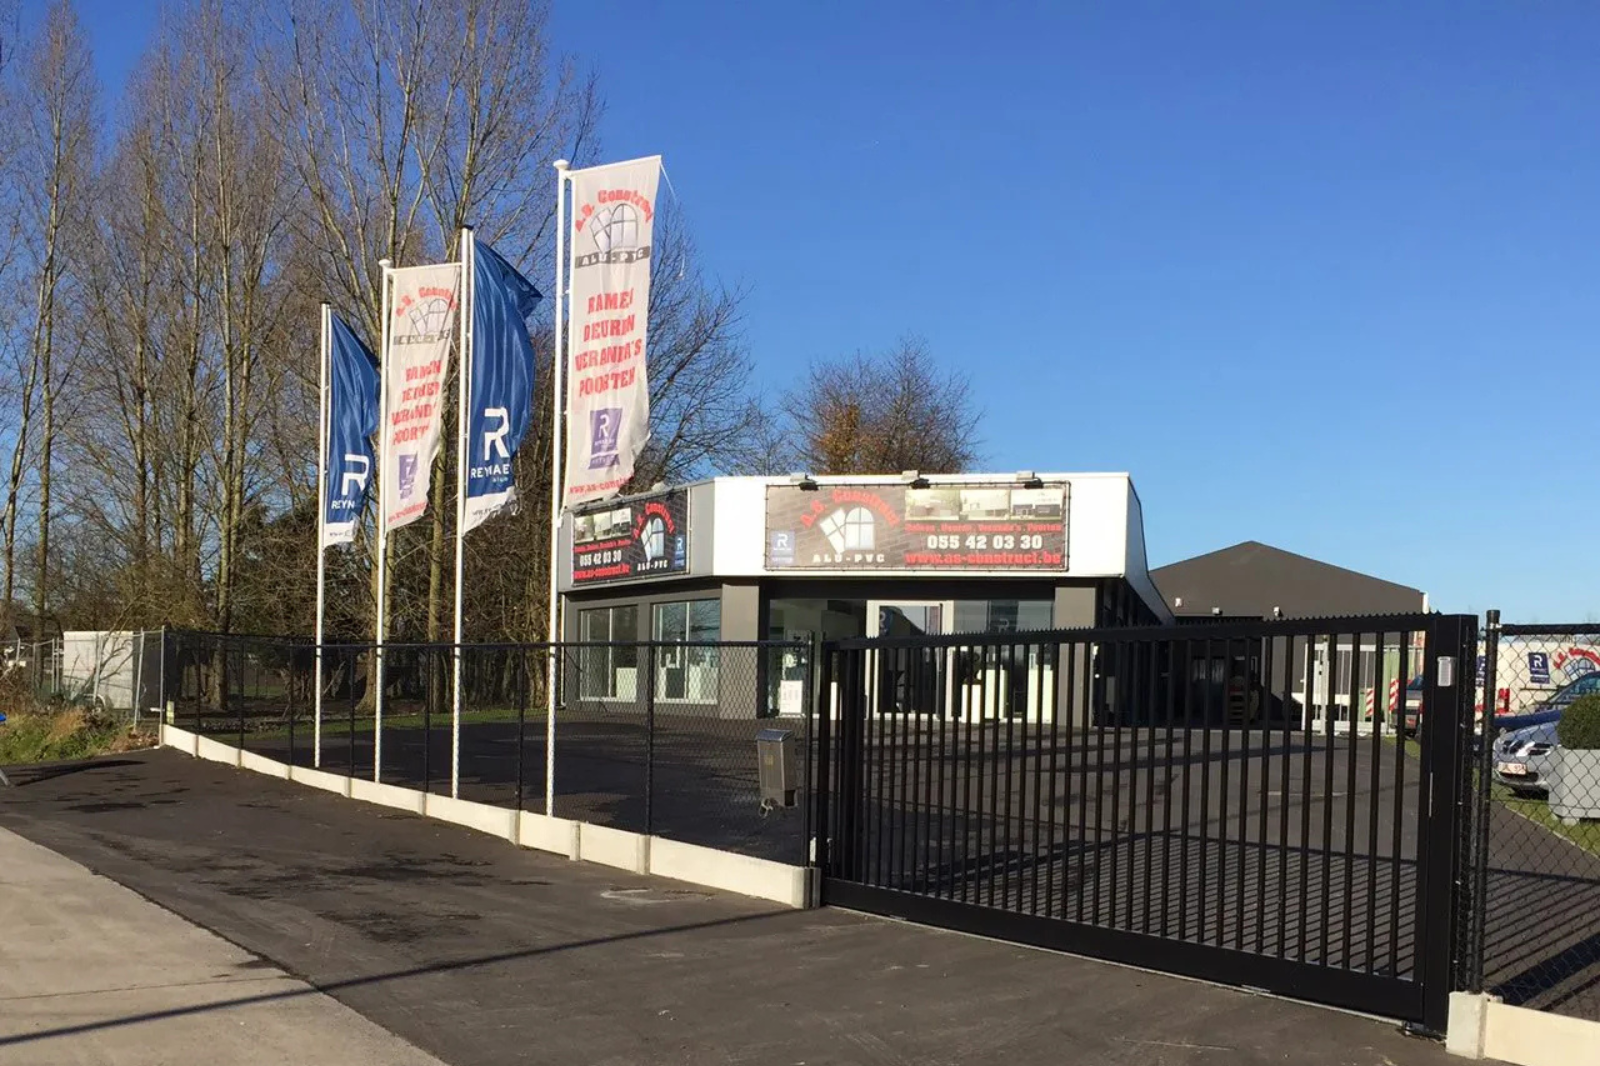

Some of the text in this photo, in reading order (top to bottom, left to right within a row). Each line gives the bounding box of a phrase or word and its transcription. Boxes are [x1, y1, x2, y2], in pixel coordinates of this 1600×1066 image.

[484, 407, 510, 460] R
[342, 453, 369, 495] R
[777, 533, 788, 548] R
[927, 534, 1043, 550] 055 42 03 30
[812, 553, 885, 564] ALU-PVC
[904, 550, 1062, 566] www.as-construct.be
